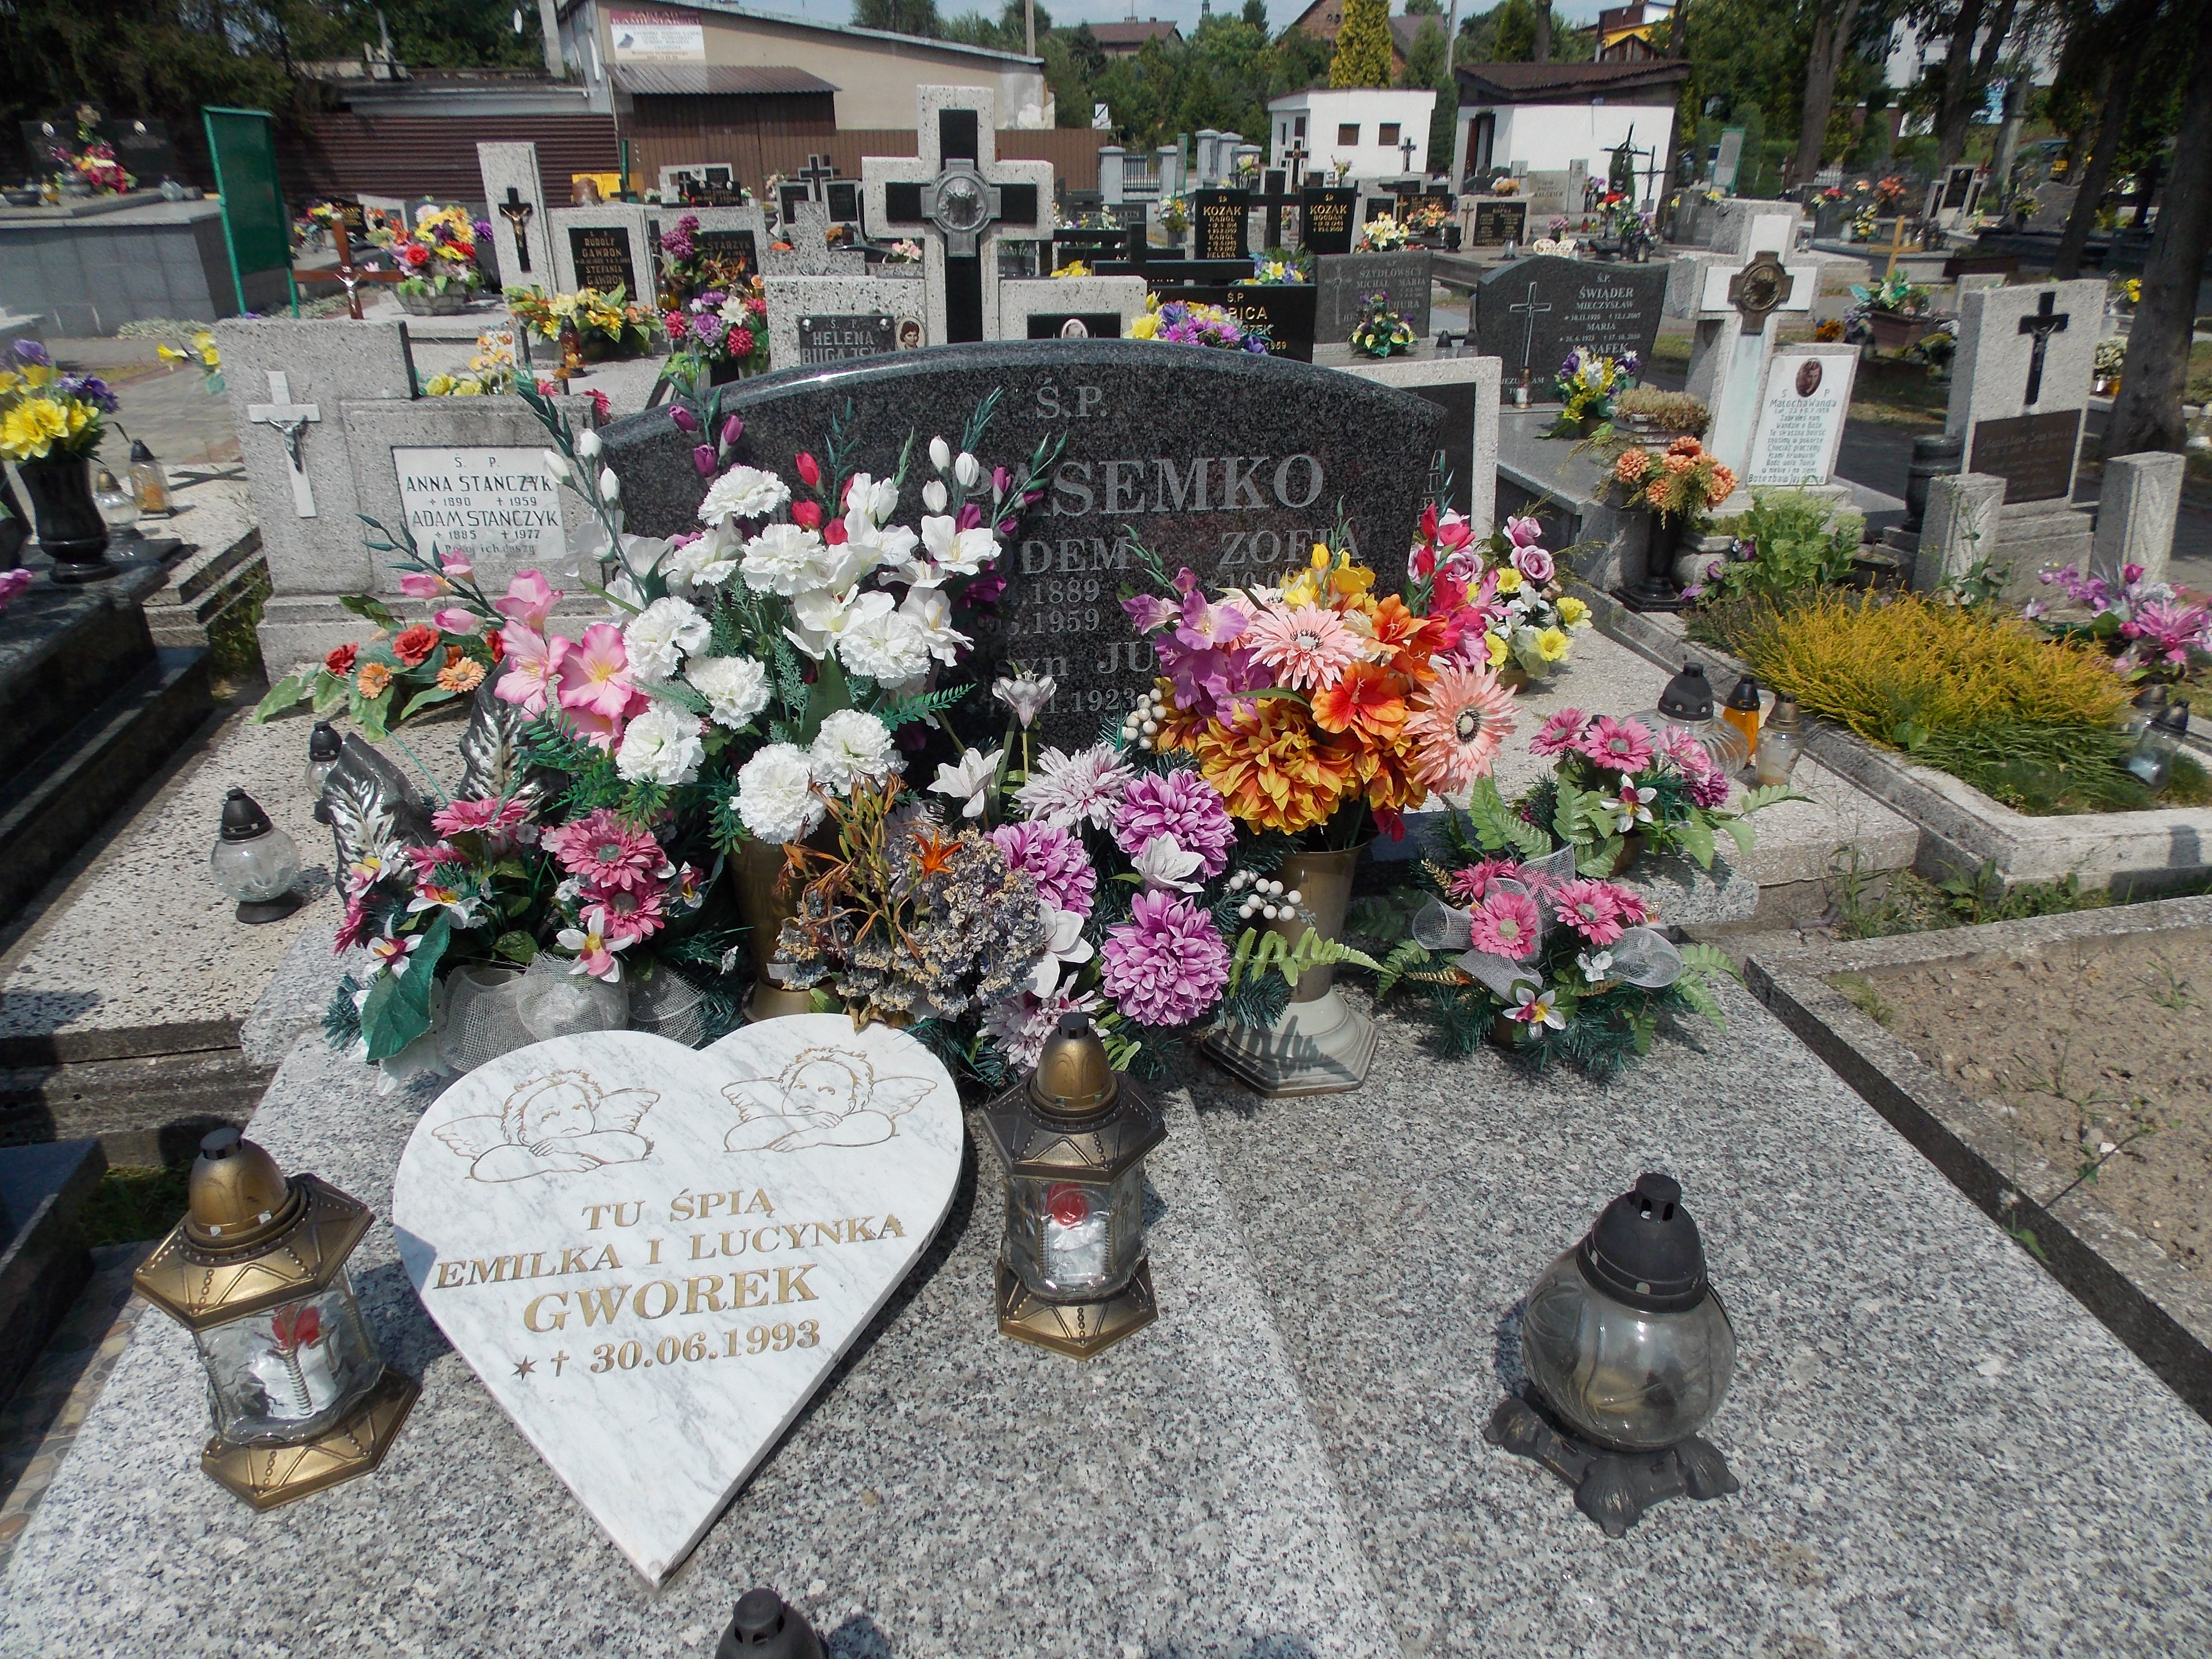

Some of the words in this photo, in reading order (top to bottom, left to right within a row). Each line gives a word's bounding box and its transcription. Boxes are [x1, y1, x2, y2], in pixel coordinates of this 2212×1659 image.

[1203, 206, 1241, 216] KOZAK
[1310, 204, 1347, 215] KOZAK
[582, 248, 622, 257] GAWRON
[585, 265, 623, 274] STEFANIA
[1578, 286, 1634, 301] ŚWIĄDER
[1575, 300, 1635, 311] MIECZYSŁAW
[1586, 322, 1616, 331] MARIA
[812, 331, 874, 346] HELENA
[407, 476, 453, 492] ANNA
[444, 497, 471, 506] 1890
[510, 496, 537, 506] 1959
[412, 510, 465, 527] ADAM
[467, 509, 560, 527] STAŃCZYK
[449, 530, 477, 539] 1885
[515, 529, 541, 539] 1977
[481, 544, 499, 553] ich
[582, 1200, 646, 1231] TU
[669, 1187, 776, 1223] ŚPIĄ
[432, 1243, 624, 1290] EMILKA
[645, 1238, 663, 1265] I
[687, 1213, 907, 1261] LUCYNKA
[523, 1263, 820, 1334] GWOREK
[590, 1319, 821, 1374] 30.06.1993
